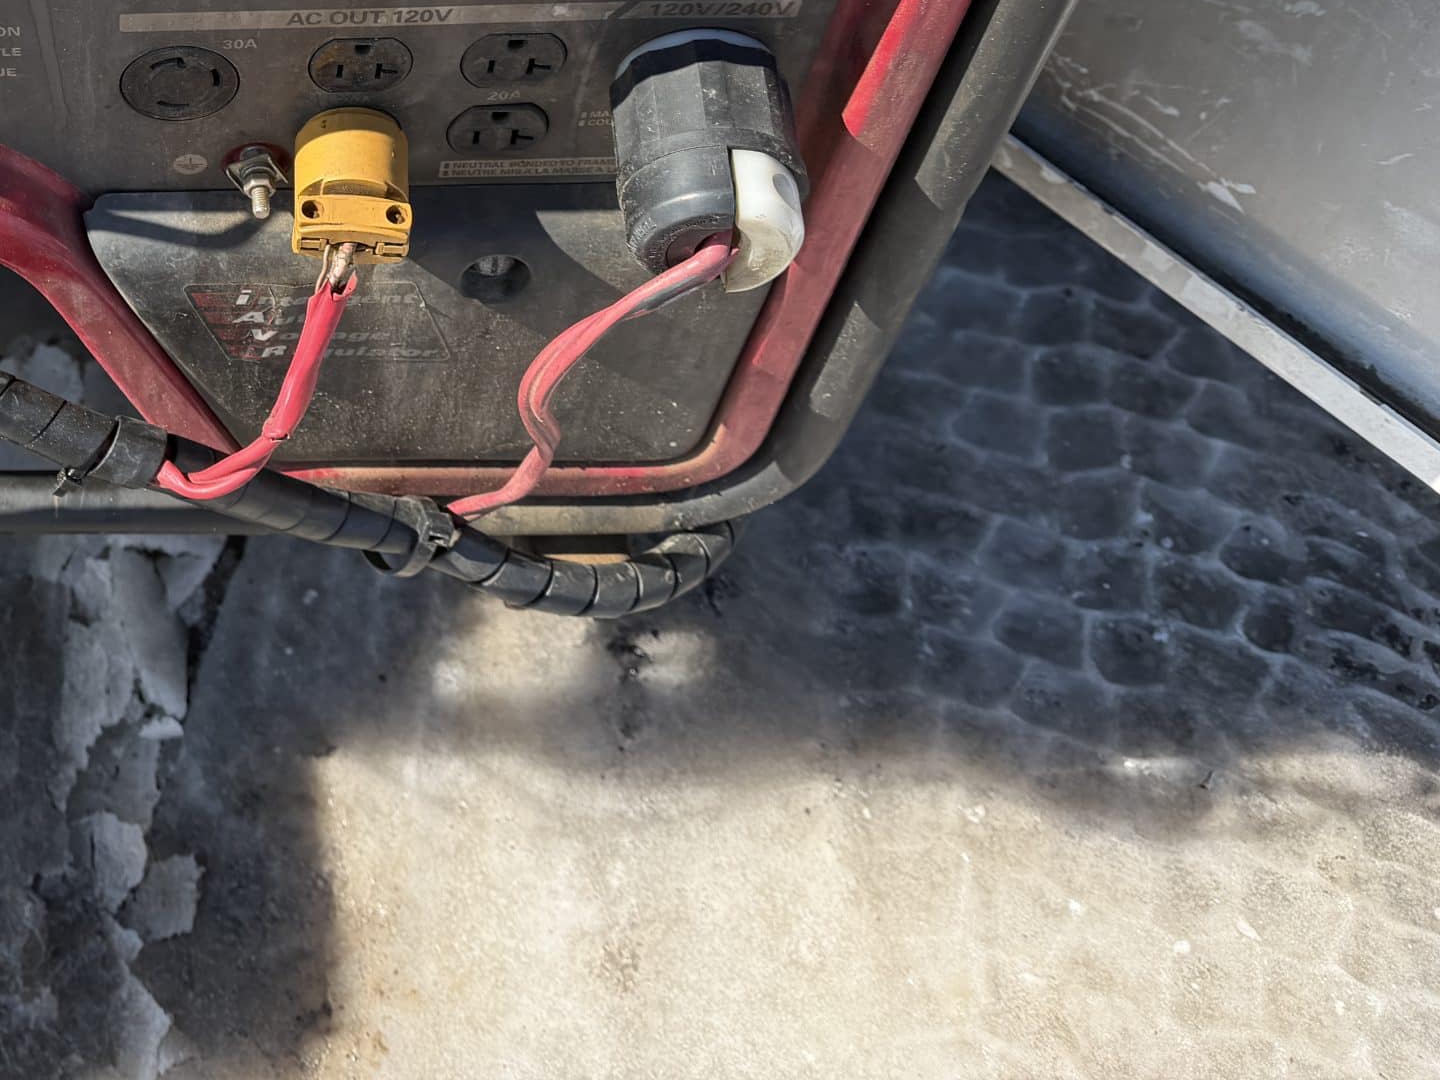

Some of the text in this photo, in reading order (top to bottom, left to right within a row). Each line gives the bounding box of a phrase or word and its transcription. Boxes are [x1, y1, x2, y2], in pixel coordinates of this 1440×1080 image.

[286, 7, 454, 27] AC OUT 120V
[649, 0, 796, 17] 120V/240V
[222, 37, 259, 50] 30A
